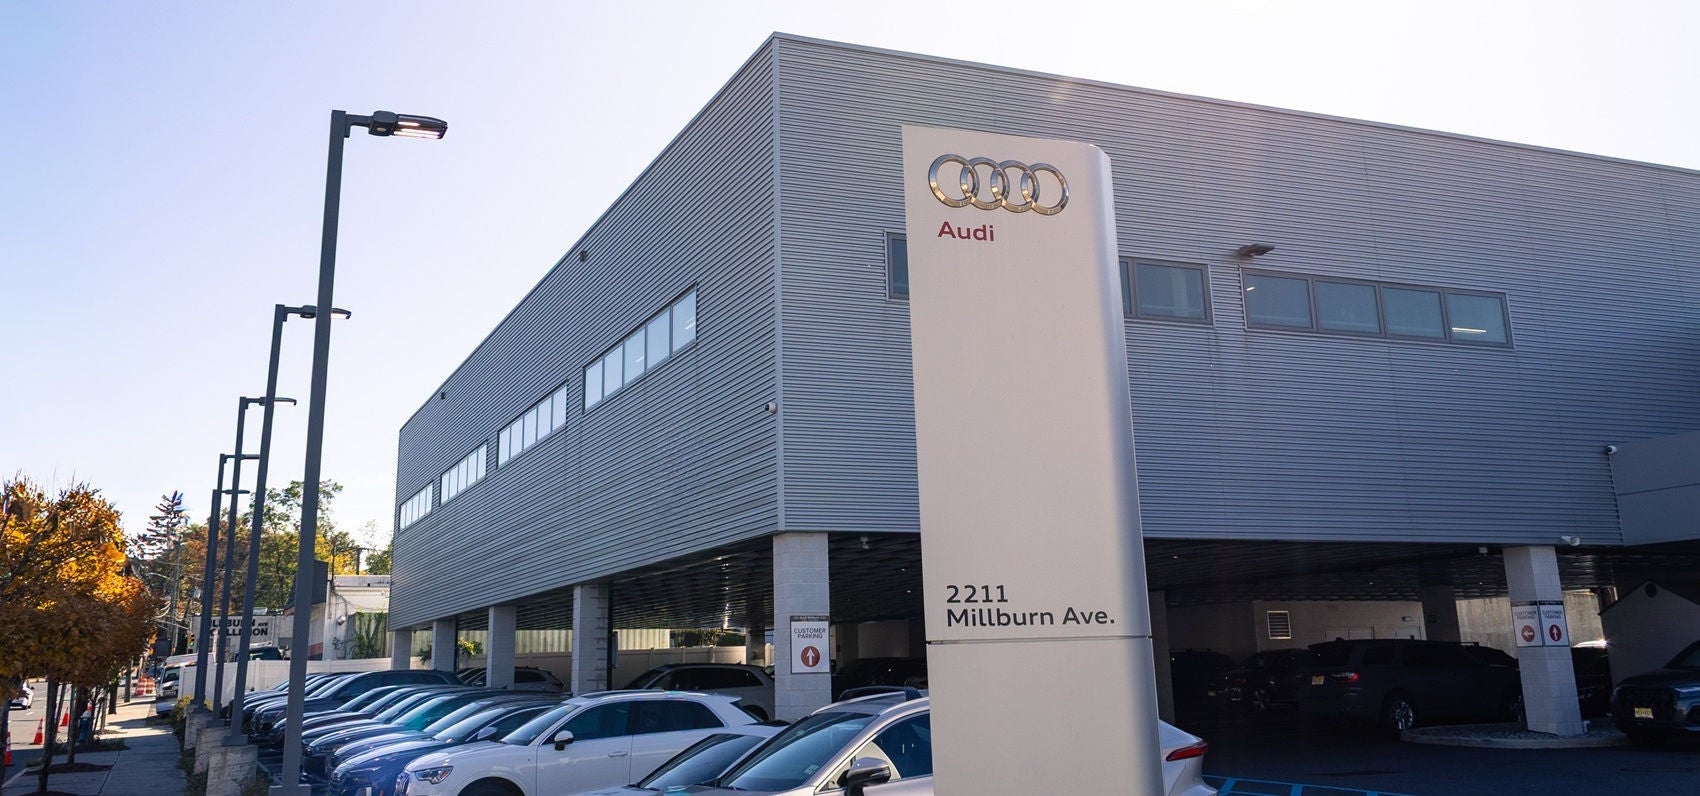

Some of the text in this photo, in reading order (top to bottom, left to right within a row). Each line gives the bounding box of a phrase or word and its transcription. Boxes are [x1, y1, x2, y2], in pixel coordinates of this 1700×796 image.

[937, 221, 995, 242] Audi
[946, 584, 1009, 604] 2211
[946, 606, 1115, 627] Millburn Ave.
